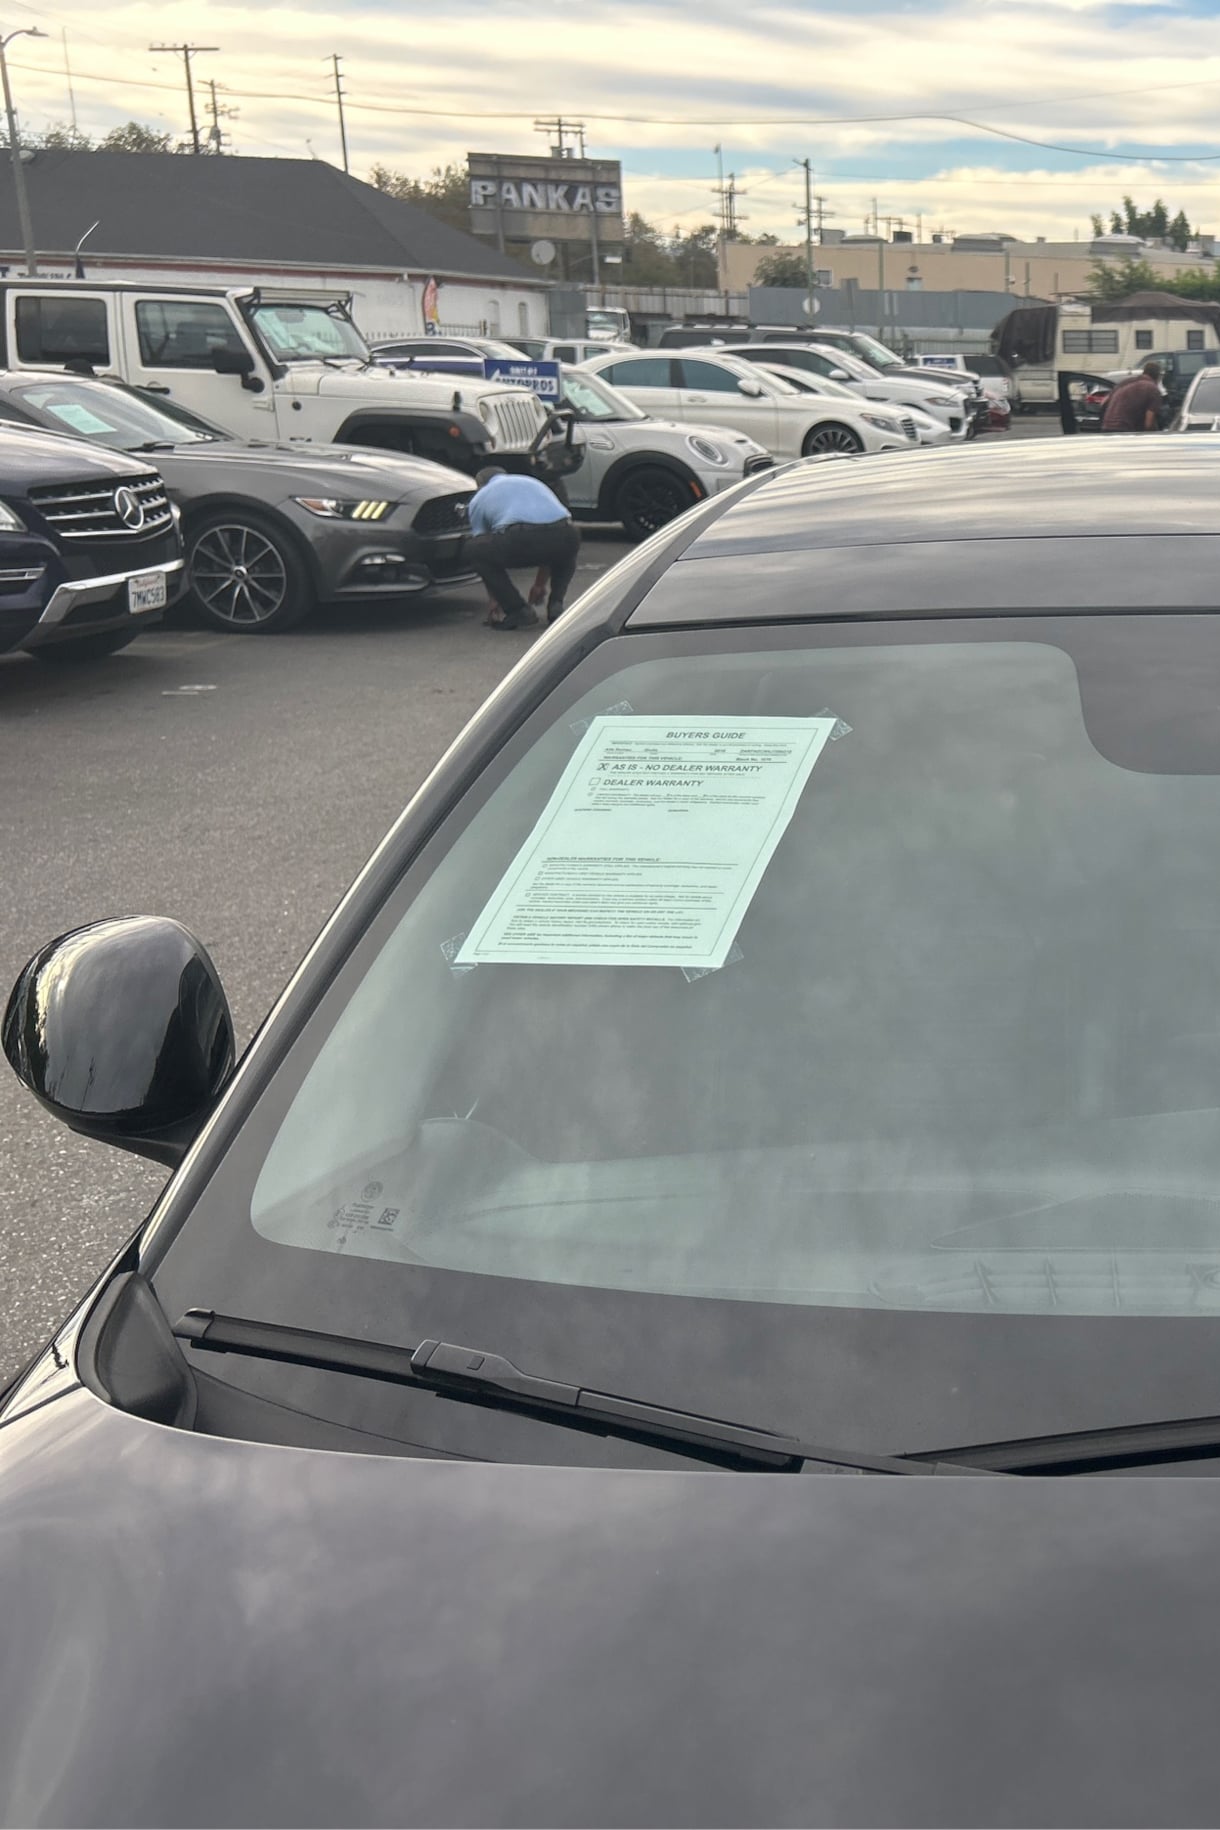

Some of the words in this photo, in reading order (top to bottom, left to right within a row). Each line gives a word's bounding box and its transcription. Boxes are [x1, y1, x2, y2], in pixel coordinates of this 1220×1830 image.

[471, 179, 620, 213] PANKAS
[666, 731, 710, 739] BUYERS
[712, 732, 746, 740] GUIDE
[661, 764, 704, 772] DEALER
